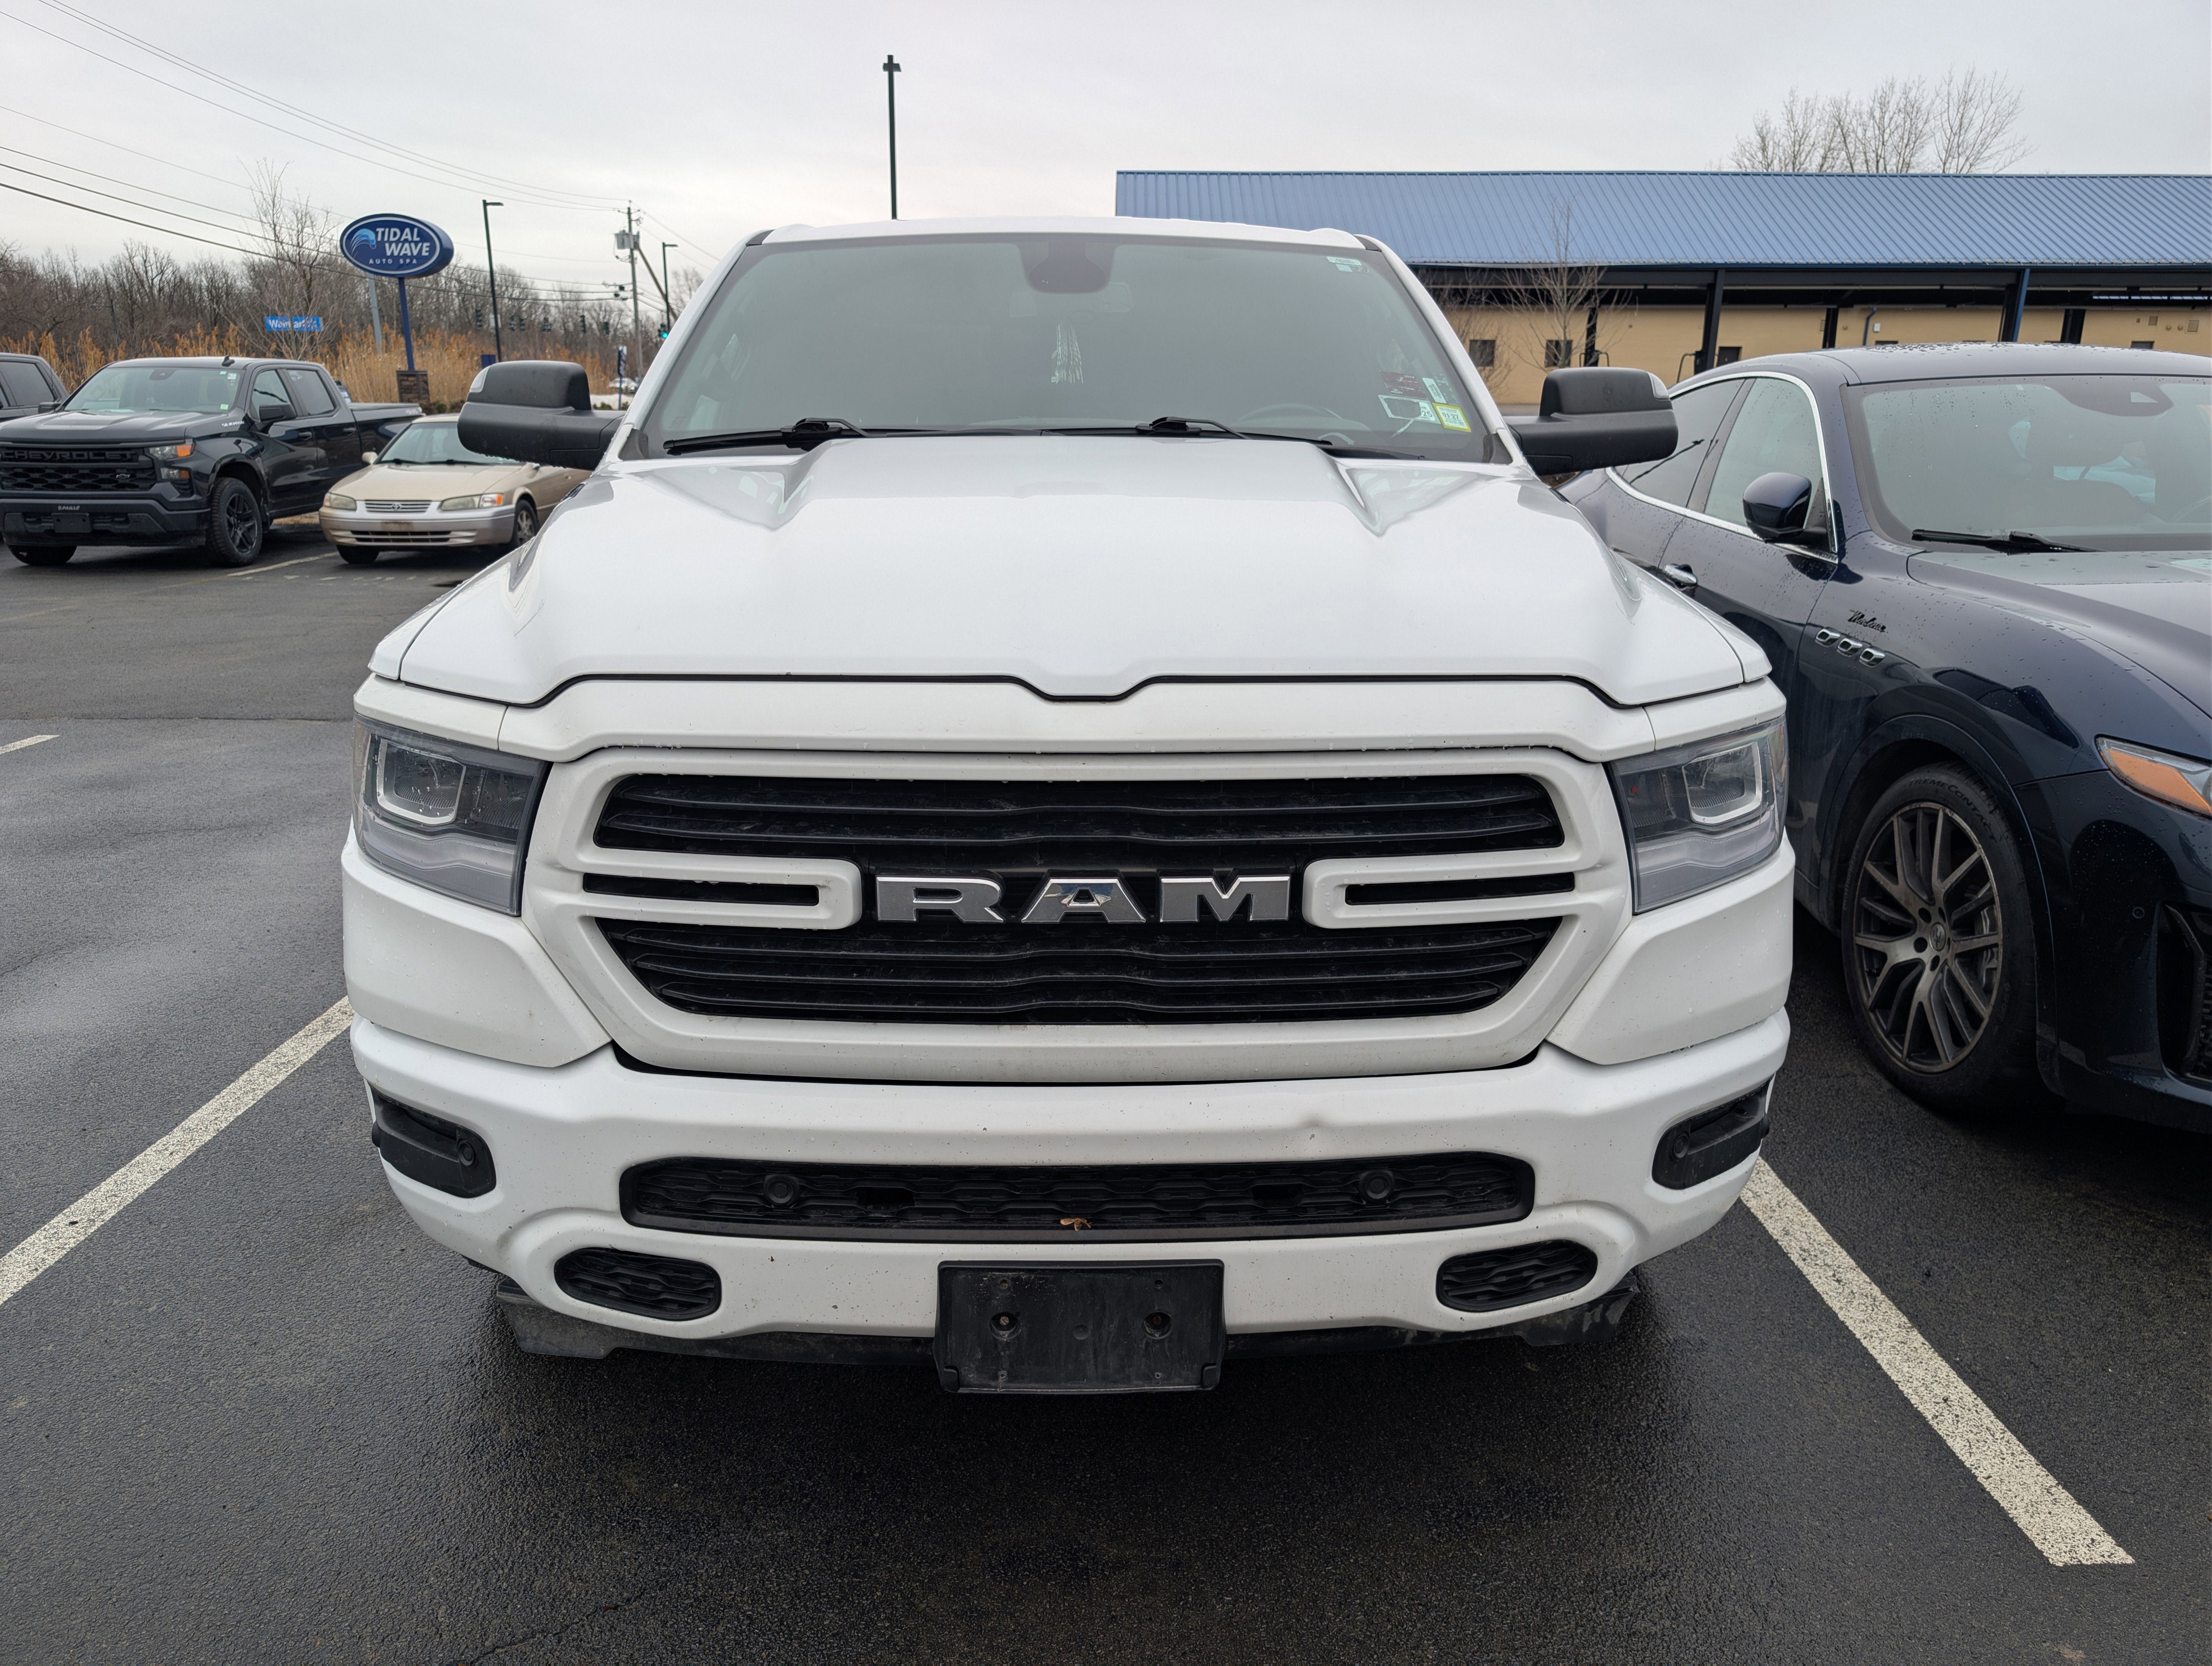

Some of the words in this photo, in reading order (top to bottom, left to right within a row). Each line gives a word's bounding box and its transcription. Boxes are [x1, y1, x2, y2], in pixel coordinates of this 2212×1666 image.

[376, 228, 420, 241] TIDAL
[385, 243, 431, 256] WAVE
[2, 450, 134, 460] CHEVROLET
[876, 875, 1292, 924] RAM
